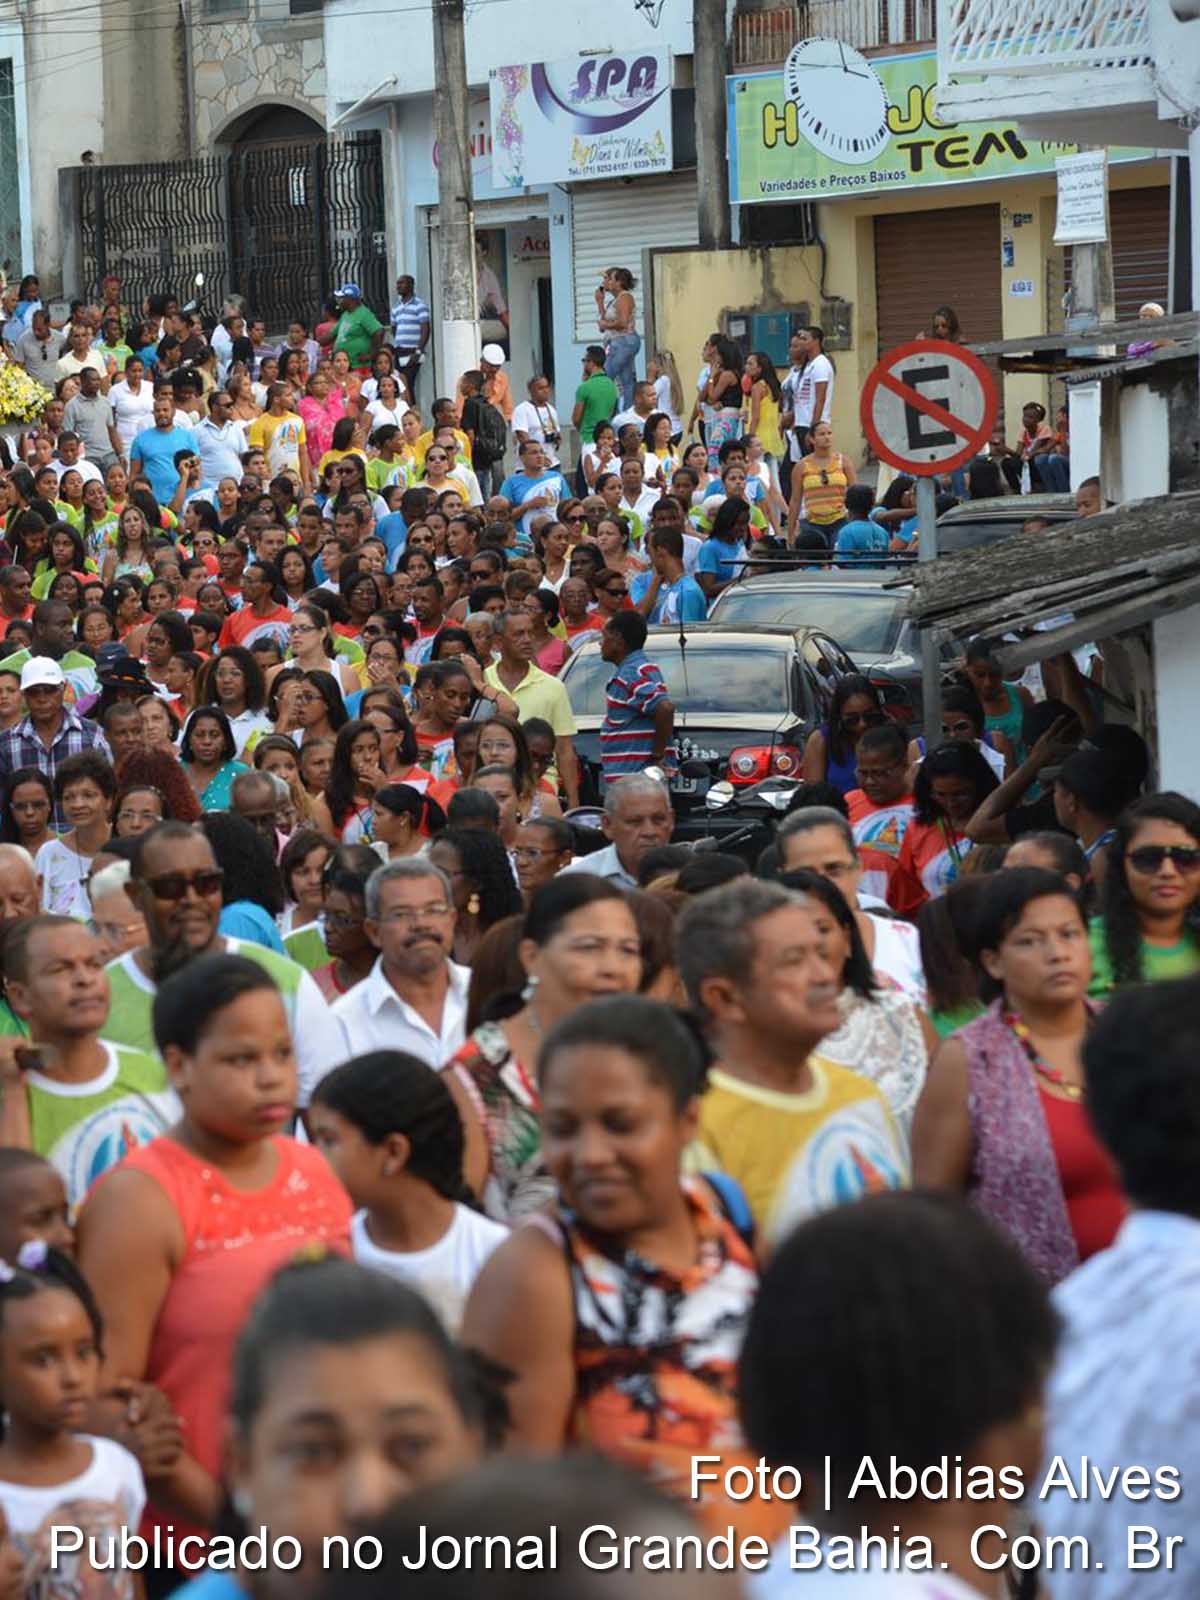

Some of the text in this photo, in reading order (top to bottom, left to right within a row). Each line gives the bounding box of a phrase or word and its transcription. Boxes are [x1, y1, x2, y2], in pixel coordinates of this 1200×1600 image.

[573, 56, 658, 98] SPA
[897, 129, 1028, 173] TEM
[760, 169, 907, 193] Variedades e Preços Baixos
[901, 365, 957, 450] E
